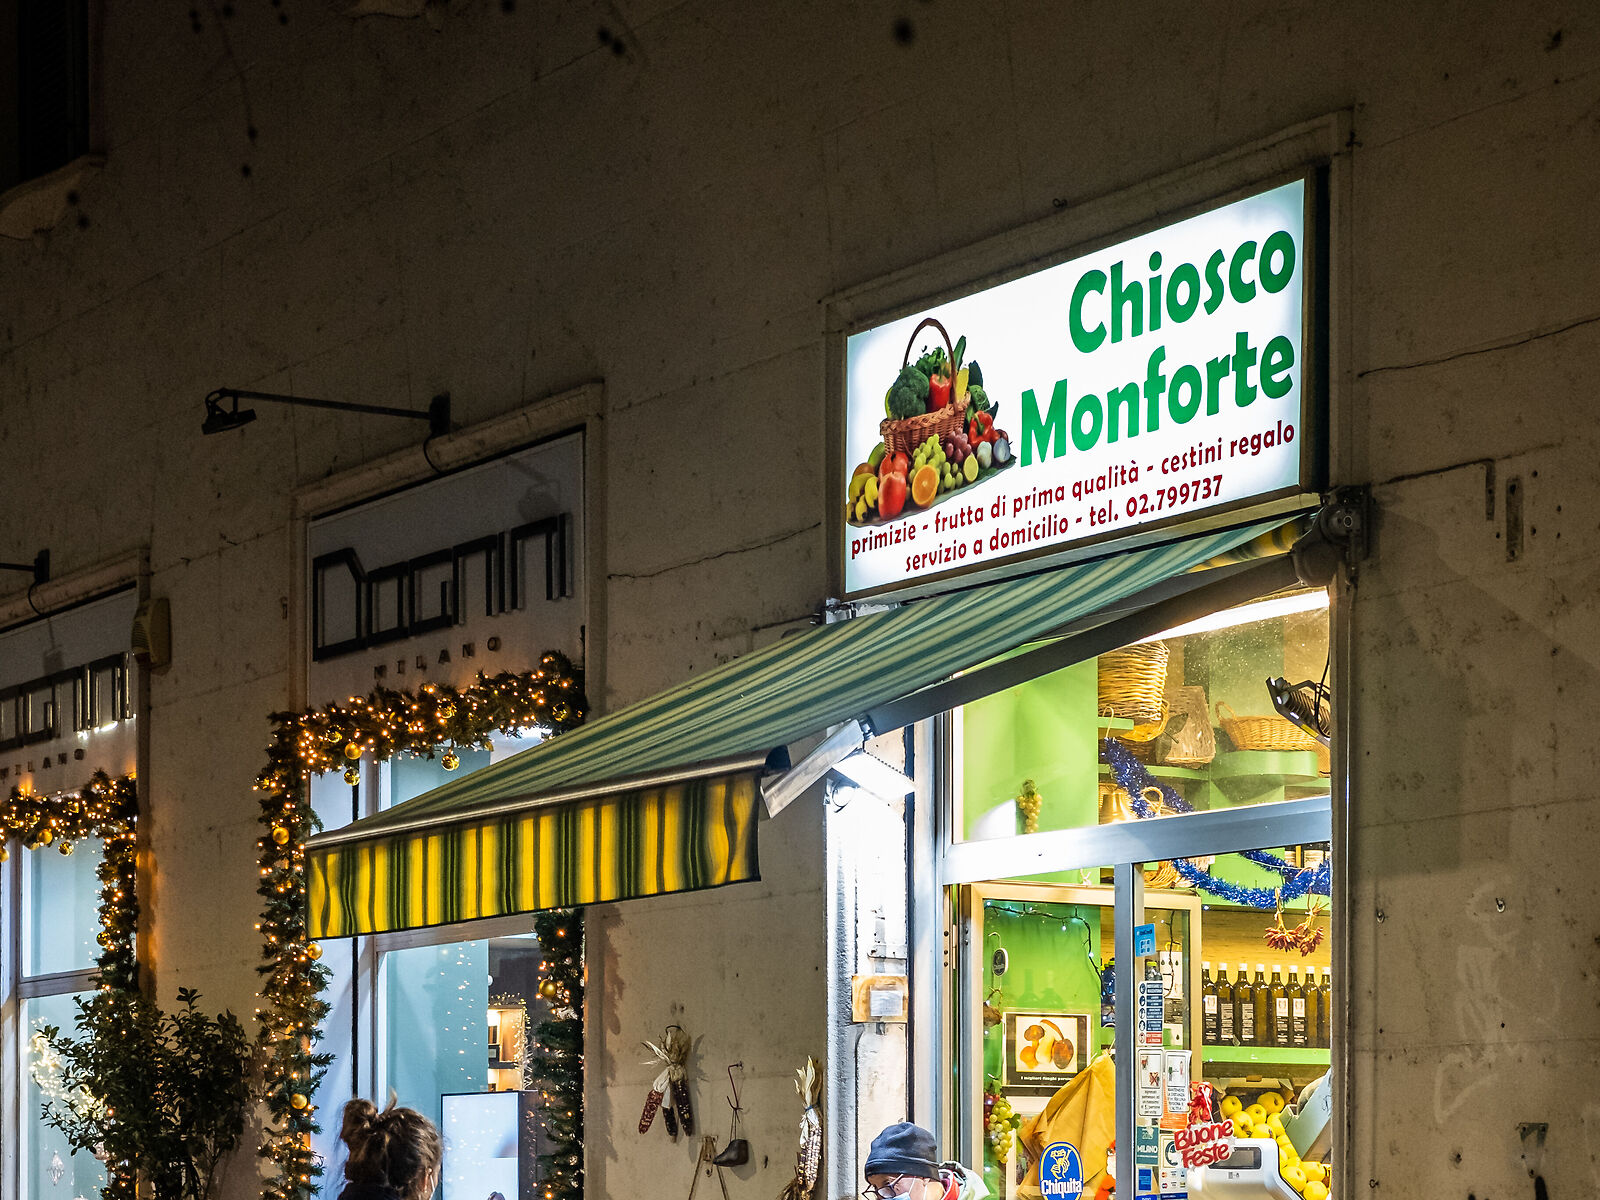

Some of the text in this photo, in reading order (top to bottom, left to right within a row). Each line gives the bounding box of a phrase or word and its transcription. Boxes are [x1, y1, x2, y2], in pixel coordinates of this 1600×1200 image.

[1068, 229, 1297, 355] Chiosco
[1019, 331, 1297, 468] Monforte
[851, 520, 916, 560] primizie
[934, 506, 984, 534] frutta
[990, 495, 1006, 519] di
[1013, 485, 1065, 518] prima
[1072, 459, 1139, 502] qualità
[1161, 437, 1222, 474] cestini
[1229, 420, 1295, 458] regalo
[905, 538, 967, 573] servizio
[973, 538, 983, 555] a
[989, 513, 1069, 551] domicilio
[1089, 499, 1119, 527] tel.
[1126, 474, 1223, 518] 02.799737
[374, 636, 500, 680] MILANO
[1174, 1120, 1233, 1151] Buone
[1182, 1143, 1229, 1168] Feste
[1041, 1178, 1082, 1199] Chiquita
